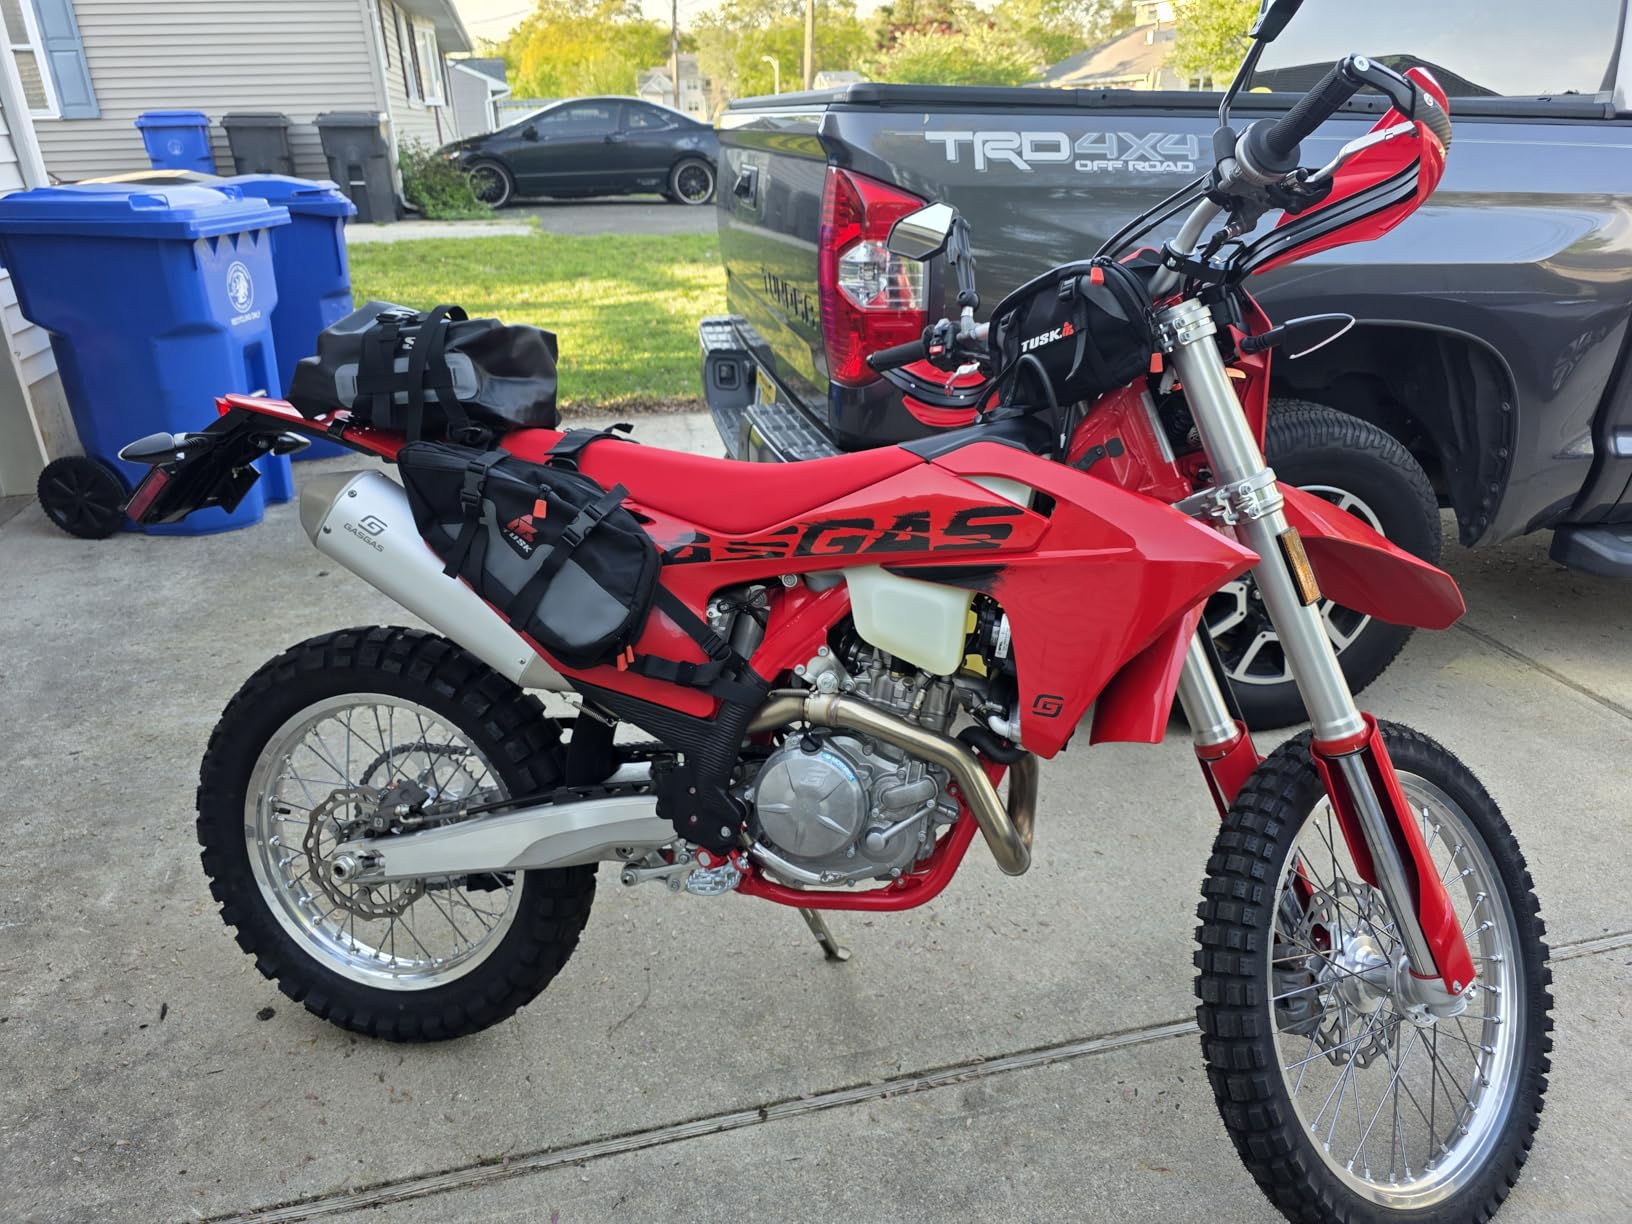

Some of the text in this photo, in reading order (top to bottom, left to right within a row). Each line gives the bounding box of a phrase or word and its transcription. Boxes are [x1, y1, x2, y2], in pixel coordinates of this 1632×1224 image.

[925, 131, 1200, 171] TRD 4X4
[1075, 160, 1194, 172] OFF ROAD
[1021, 328, 1062, 352] TUSK
[343, 522, 385, 553] GASGAS
[663, 505, 1025, 566] ASGAS
